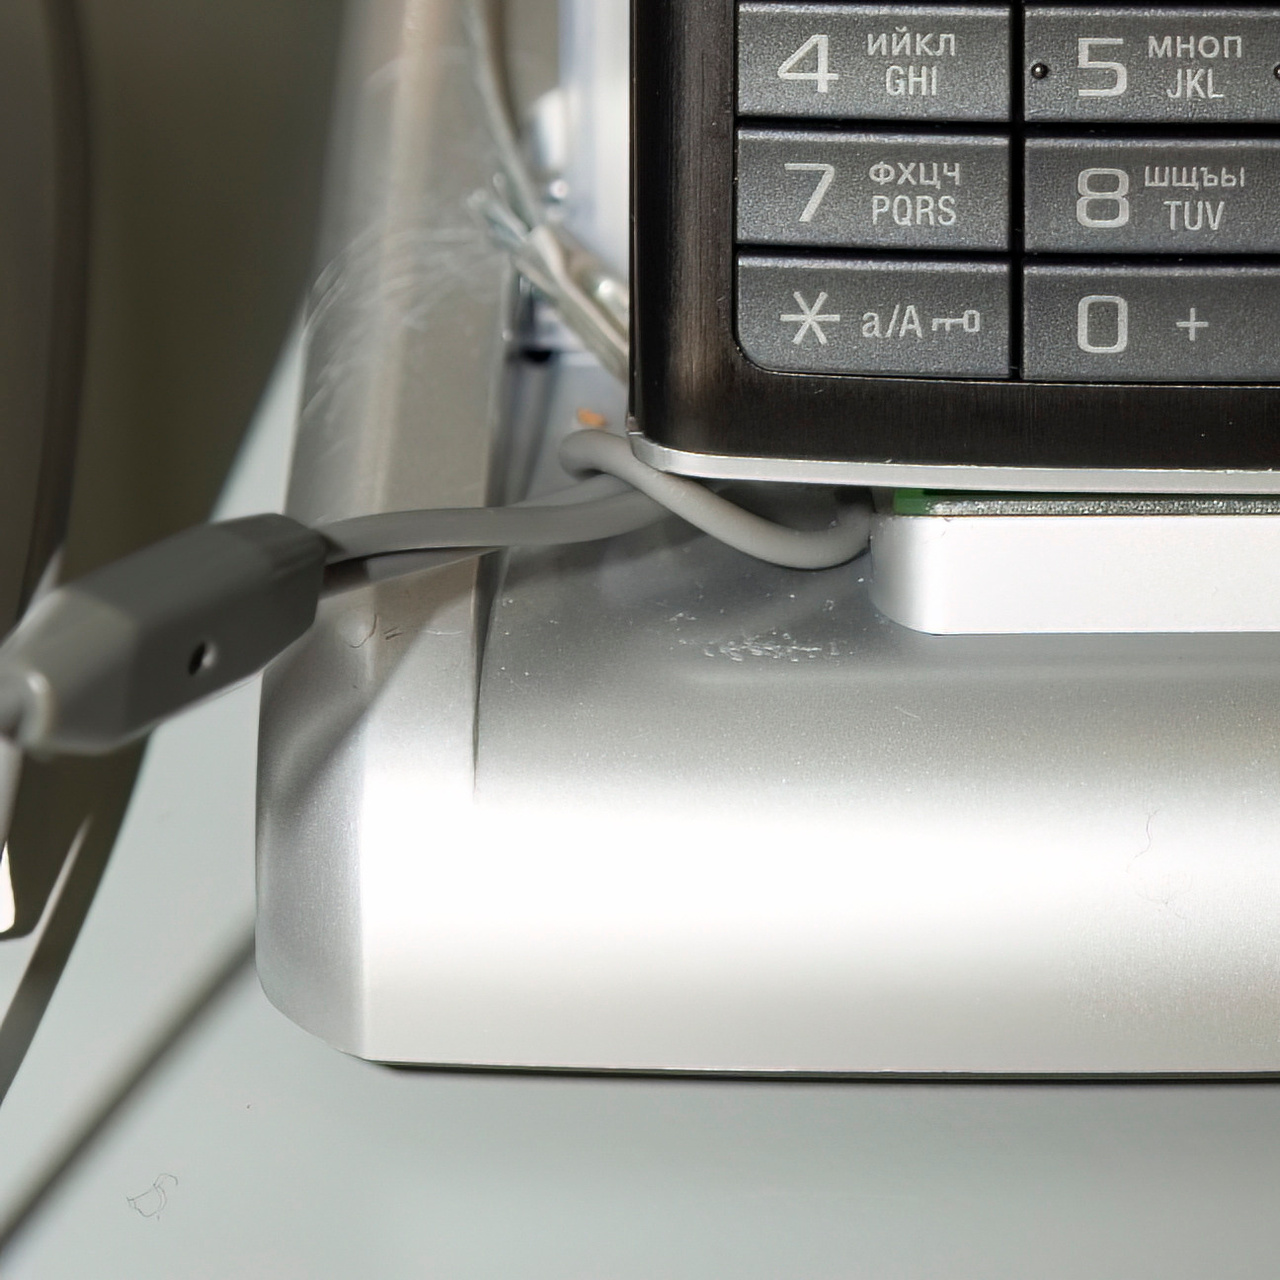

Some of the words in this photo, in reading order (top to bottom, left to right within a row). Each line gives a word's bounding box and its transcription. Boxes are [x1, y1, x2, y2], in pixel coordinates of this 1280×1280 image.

[866, 29, 957, 57] ИЙКЛ
[1147, 35, 1244, 58] МНОП
[776, 33, 839, 94] 4
[1076, 36, 1129, 97] 5
[884, 64, 938, 96] GHI
[1165, 69, 1226, 100] JKL
[867, 160, 962, 189] ФХЦЧ
[1143, 165, 1247, 190] ШЩЪЫ
[783, 162, 836, 223] 7
[1076, 167, 1130, 228] 8
[871, 194, 957, 227] PQRS
[1162, 199, 1222, 231] TUV
[861, 304, 923, 337] a/A
[1076, 295, 1128, 353] 0
